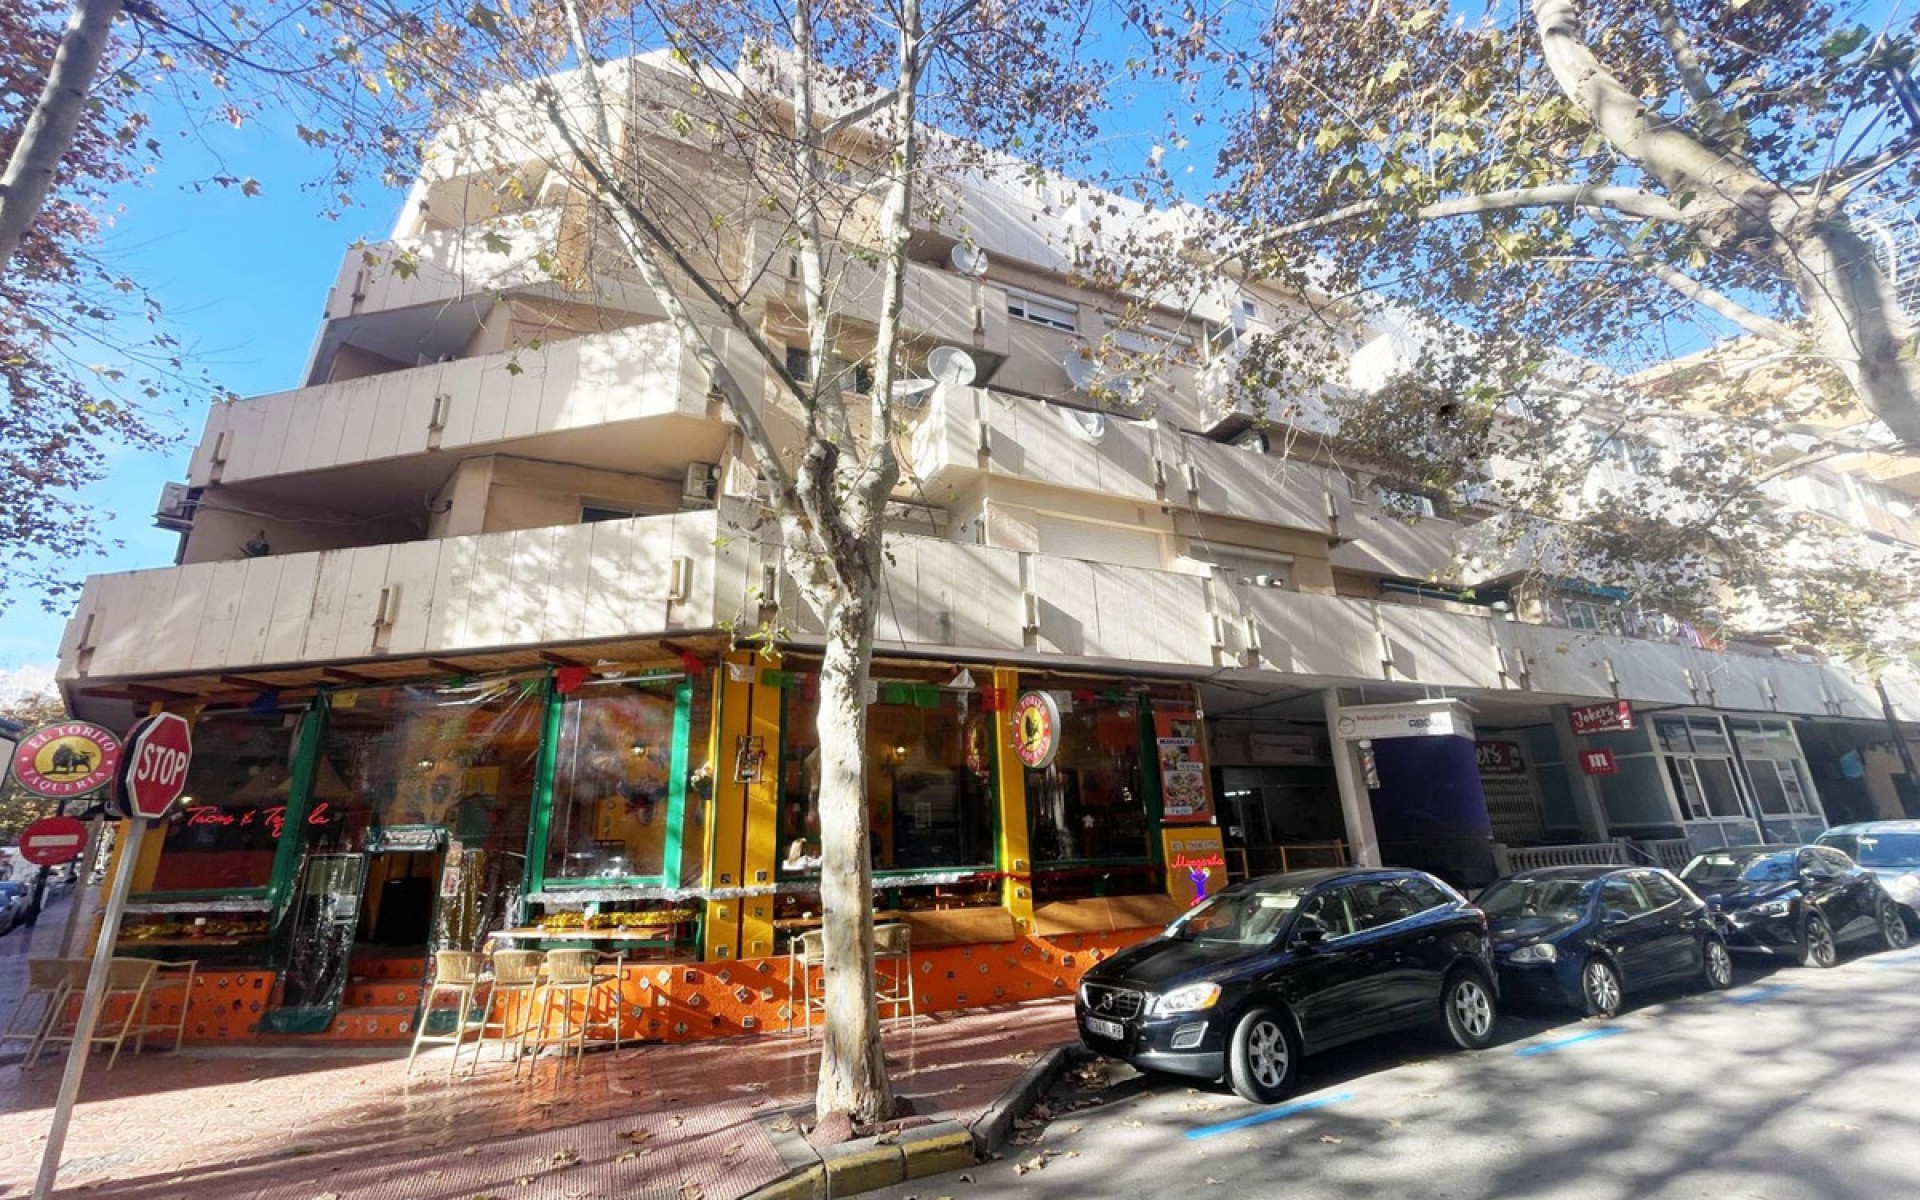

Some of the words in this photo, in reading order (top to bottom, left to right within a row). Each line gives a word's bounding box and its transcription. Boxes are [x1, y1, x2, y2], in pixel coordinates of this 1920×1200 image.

[28, 730, 53, 749] EL
[56, 725, 117, 752] TORITO
[137, 743, 187, 787] STOP
[186, 805, 234, 827] Tacos
